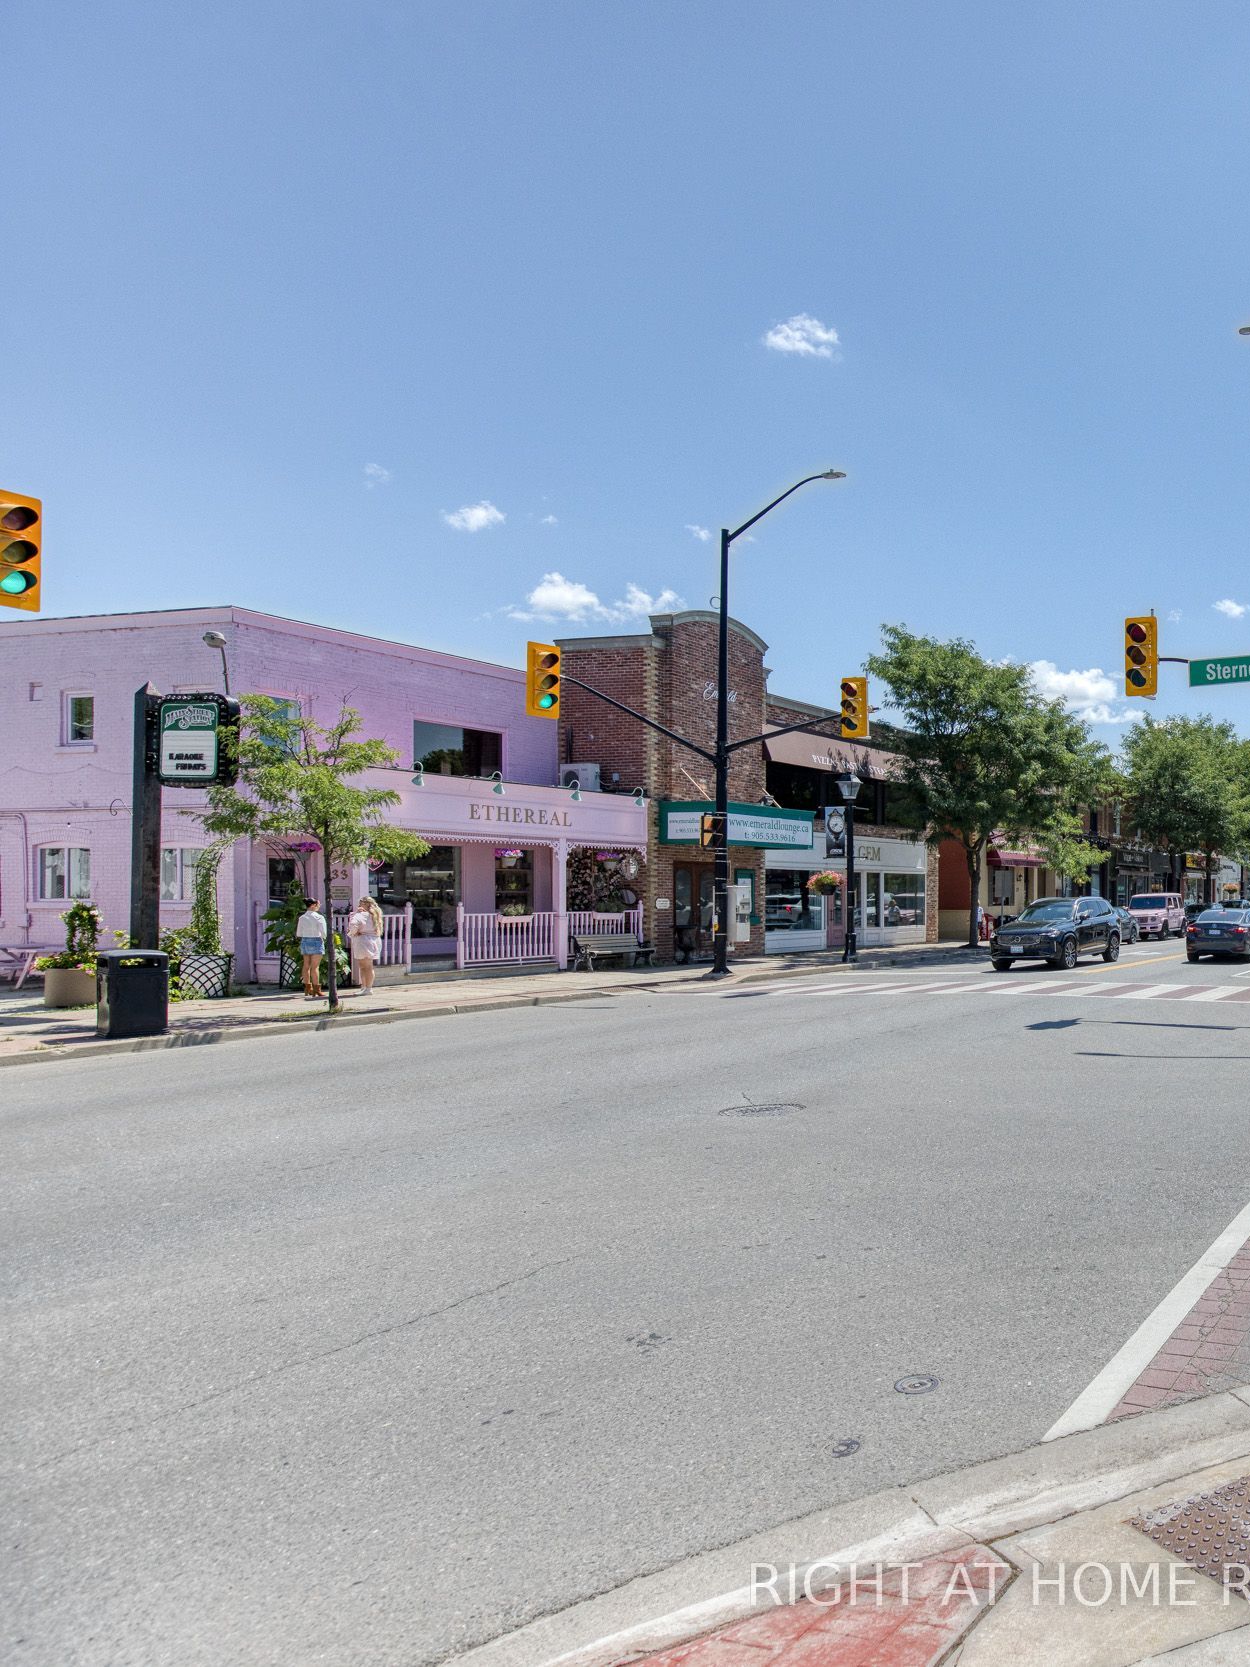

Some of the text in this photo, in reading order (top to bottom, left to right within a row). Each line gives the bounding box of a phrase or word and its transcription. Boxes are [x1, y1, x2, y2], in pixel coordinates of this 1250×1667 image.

[469, 803, 573, 827] ETHEREAL
[728, 819, 809, 834] www.emeraldlounge.ca
[751, 831, 796, 842] 905.533.9616
[858, 845, 881, 861] GEM
